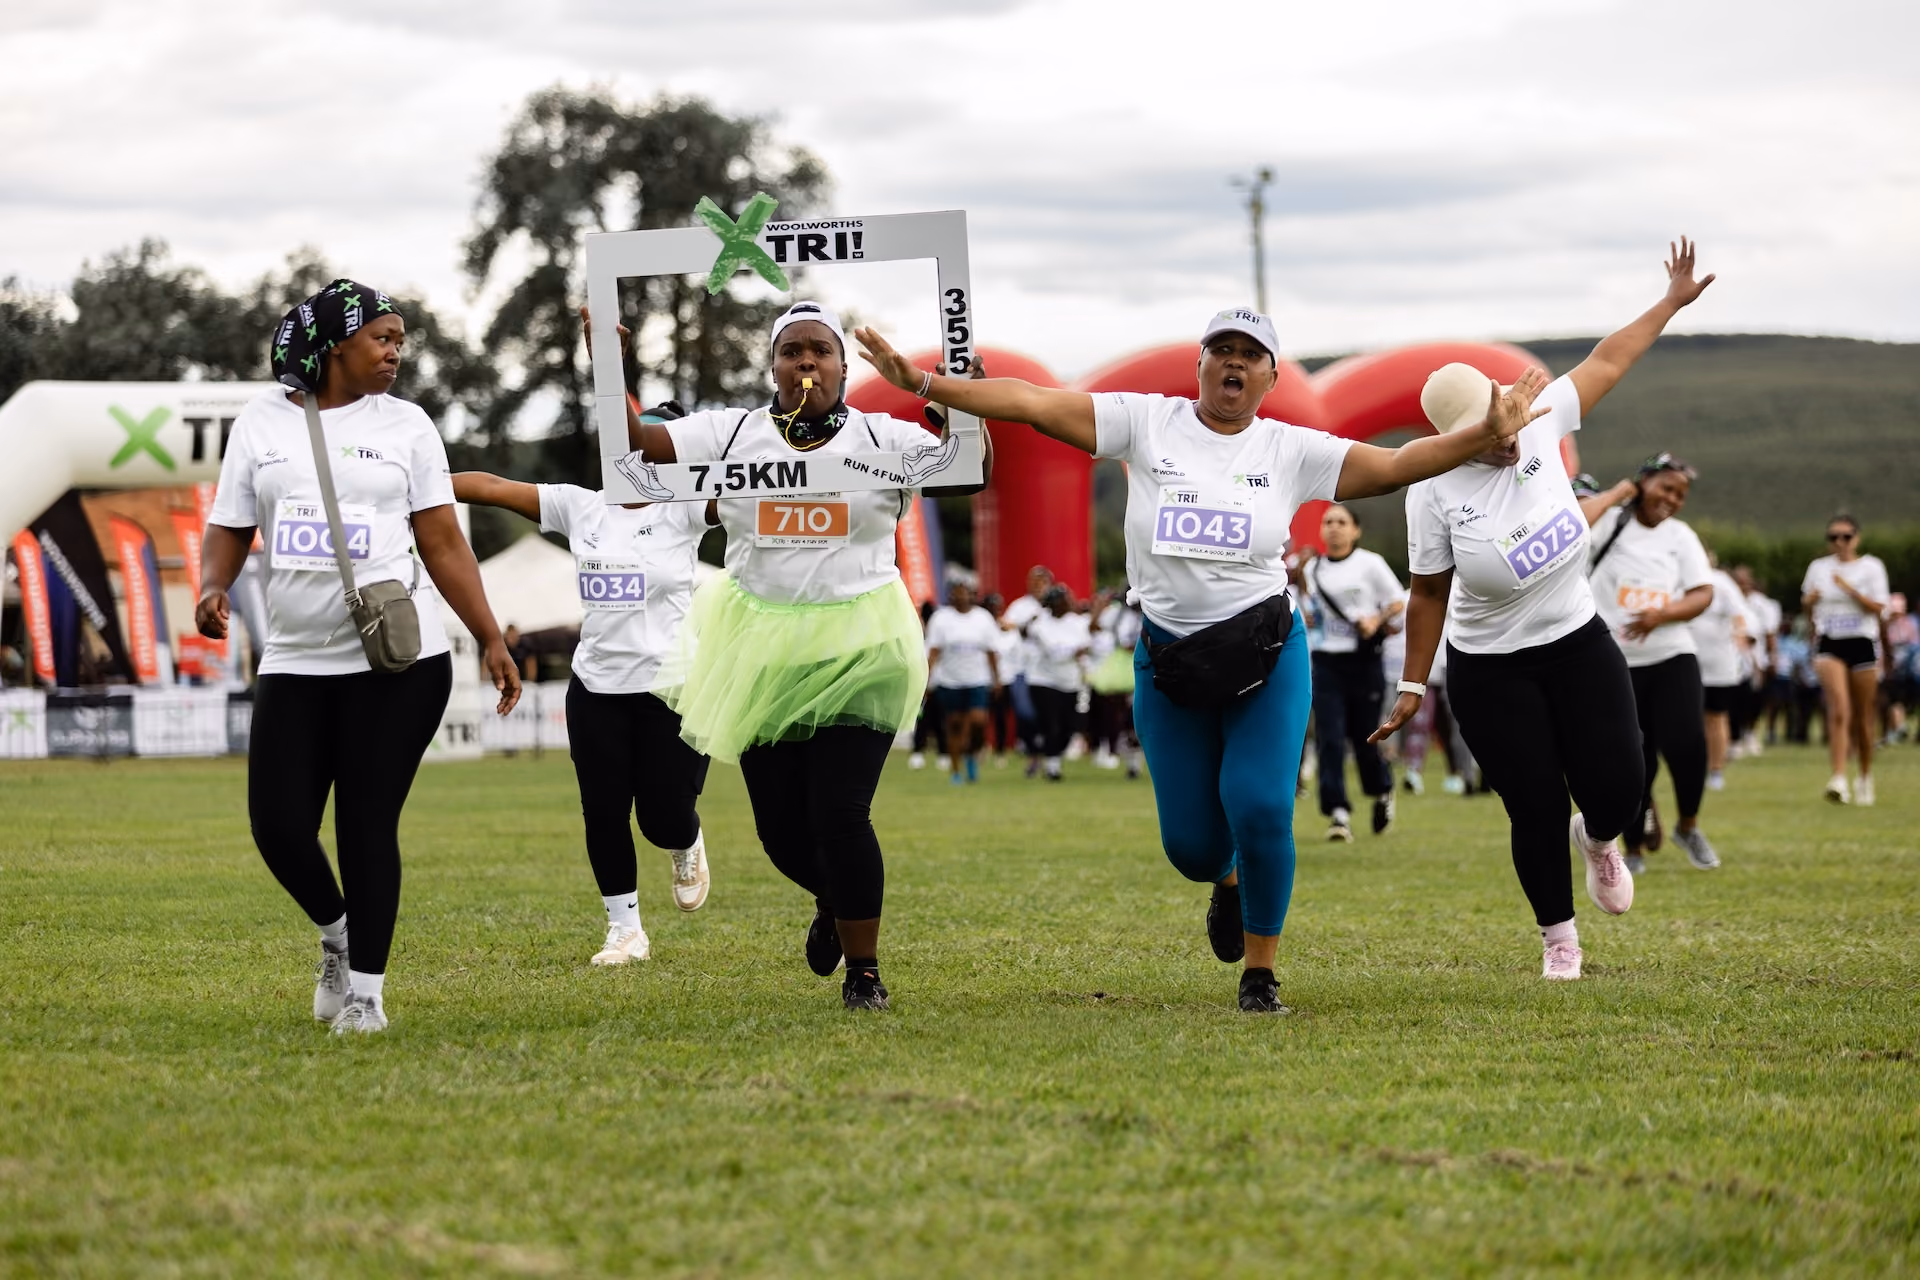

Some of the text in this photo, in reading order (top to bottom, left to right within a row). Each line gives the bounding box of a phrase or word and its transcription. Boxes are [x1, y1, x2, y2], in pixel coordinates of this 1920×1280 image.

[766, 220, 864, 231] WOOLWORTHS
[766, 231, 864, 262] TRI!
[1235, 311, 1260, 325] TRI!
[944, 288, 971, 374] 355
[843, 457, 870, 474] RUN
[1160, 469, 1186, 477] WORLD
[1524, 457, 1544, 476] TRI!
[689, 461, 807, 498] 7,5KM
[1246, 477, 1270, 488] TRI!
[1177, 492, 1199, 503] TRI!
[774, 506, 833, 532] 710
[1162, 511, 1249, 544] 1043
[1511, 525, 1531, 543] TRI!
[1514, 514, 1578, 572] 1073
[581, 576, 642, 599] 1034
